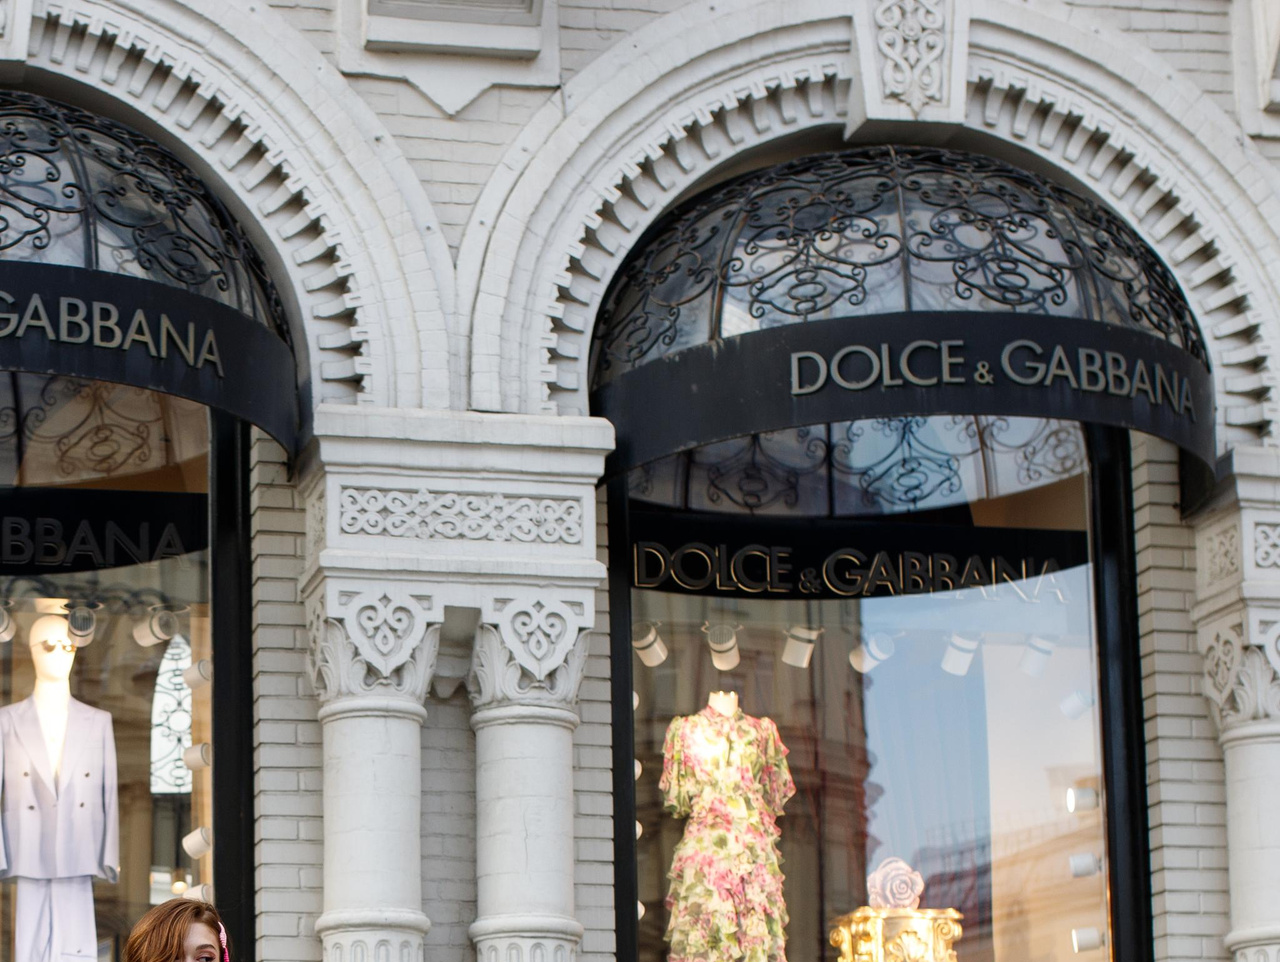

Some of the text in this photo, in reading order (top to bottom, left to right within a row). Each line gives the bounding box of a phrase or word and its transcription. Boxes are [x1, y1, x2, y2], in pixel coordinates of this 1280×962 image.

[790, 340, 1196, 421] DOLCE & GABBANA
[634, 541, 1070, 603] DOLCE & GABBANA
